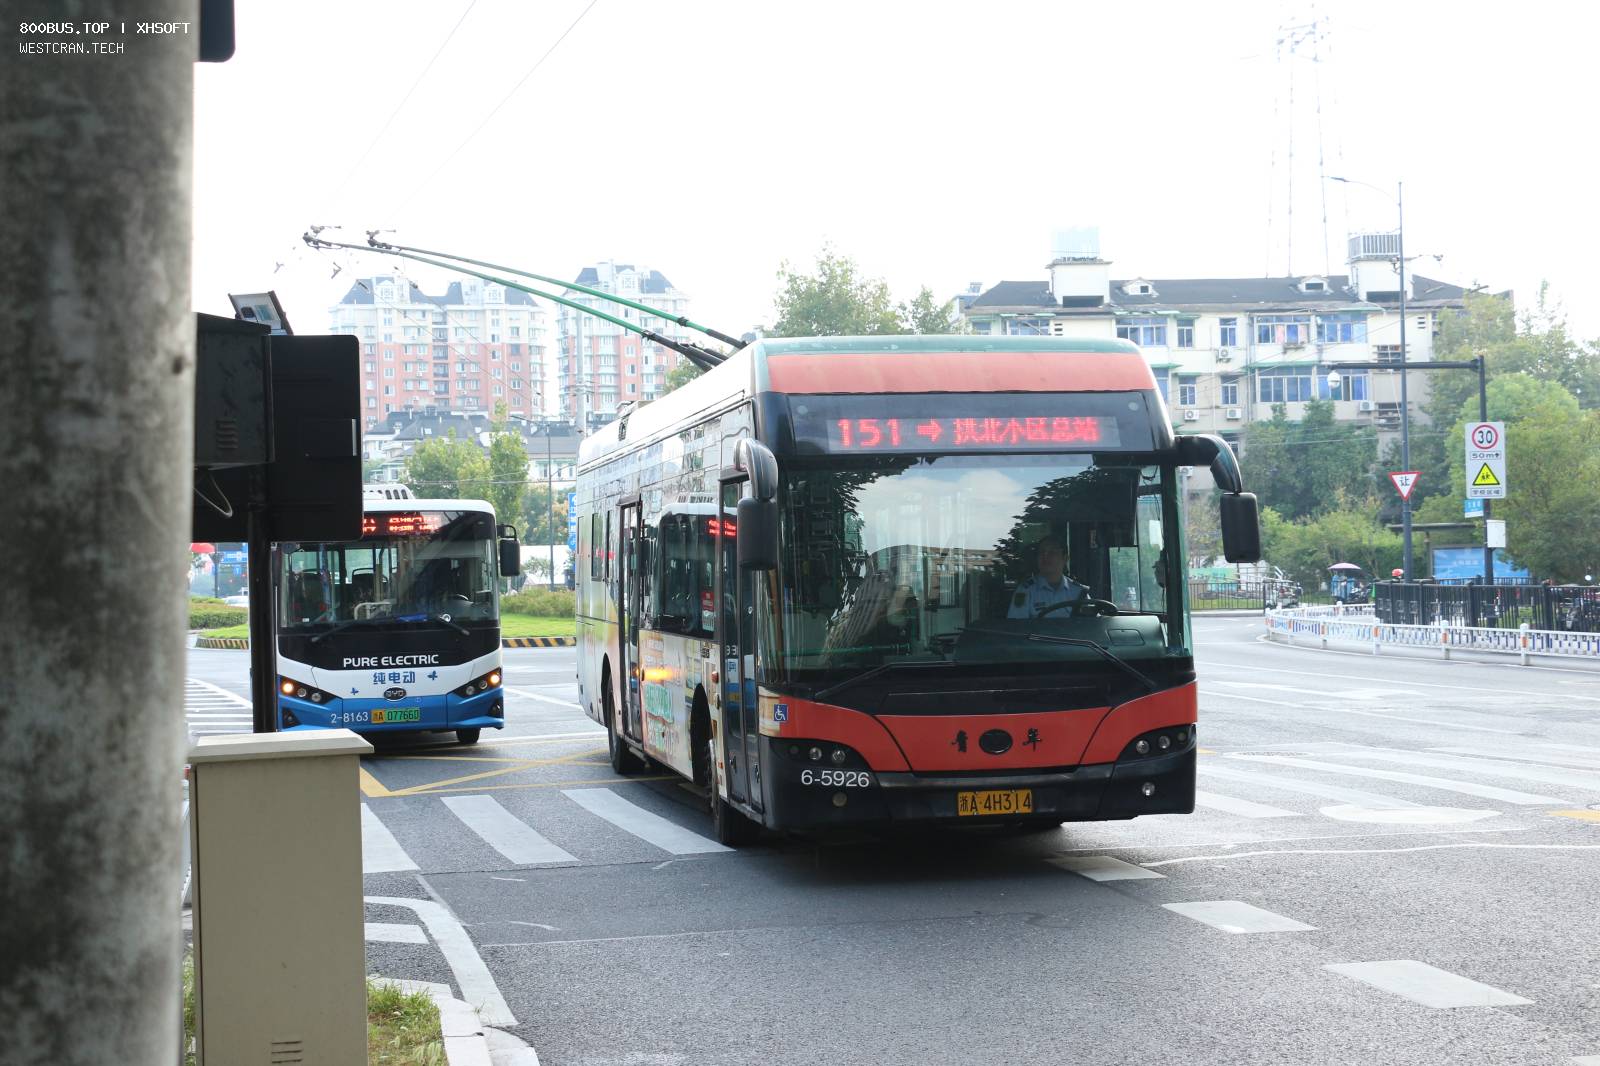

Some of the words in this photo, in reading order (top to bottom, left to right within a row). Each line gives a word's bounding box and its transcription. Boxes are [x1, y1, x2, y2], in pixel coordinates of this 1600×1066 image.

[838, 418, 899, 448] 151
[1477, 430, 1493, 444] 30
[1399, 475, 1410, 486] 让
[343, 655, 378, 667] PURE
[381, 654, 439, 666] ELECTRIC
[373, 671, 416, 684] 纯电动
[330, 711, 369, 724] 2-8163
[800, 769, 870, 788] 6-5926
